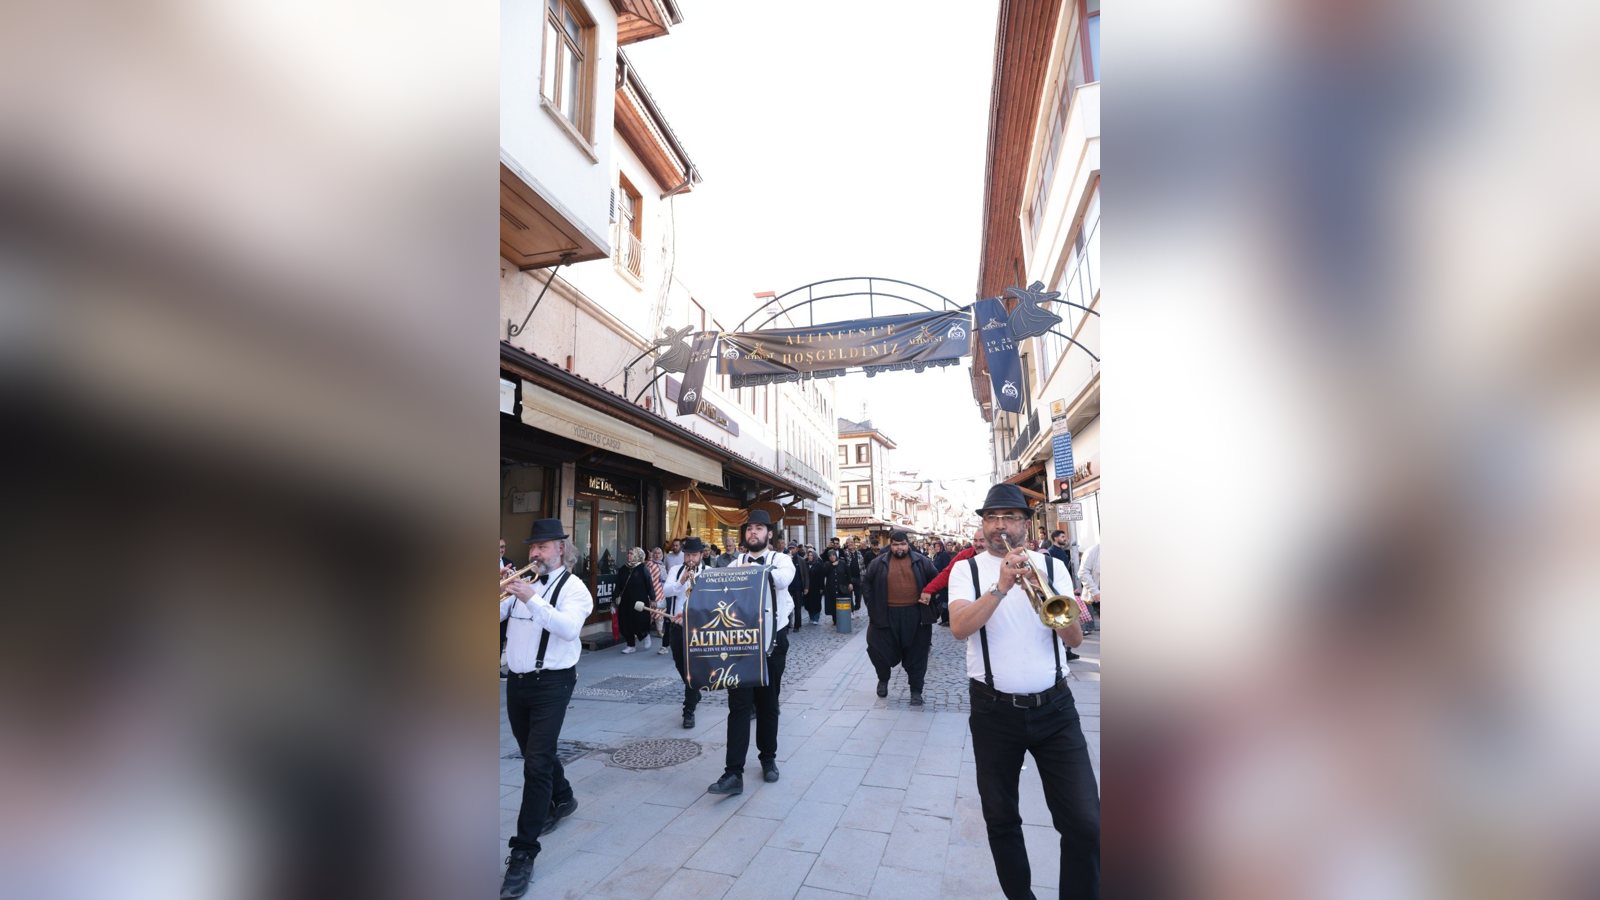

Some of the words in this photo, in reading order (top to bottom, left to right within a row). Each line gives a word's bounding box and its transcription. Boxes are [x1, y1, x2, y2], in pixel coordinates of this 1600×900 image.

[785, 324, 896, 346] ALTINFEST'E
[783, 340, 898, 365] HOŞGELDİNİZ
[988, 344, 1014, 354] EKİM
[588, 476, 614, 492] METAL
[689, 628, 760, 647] ALTINFEST
